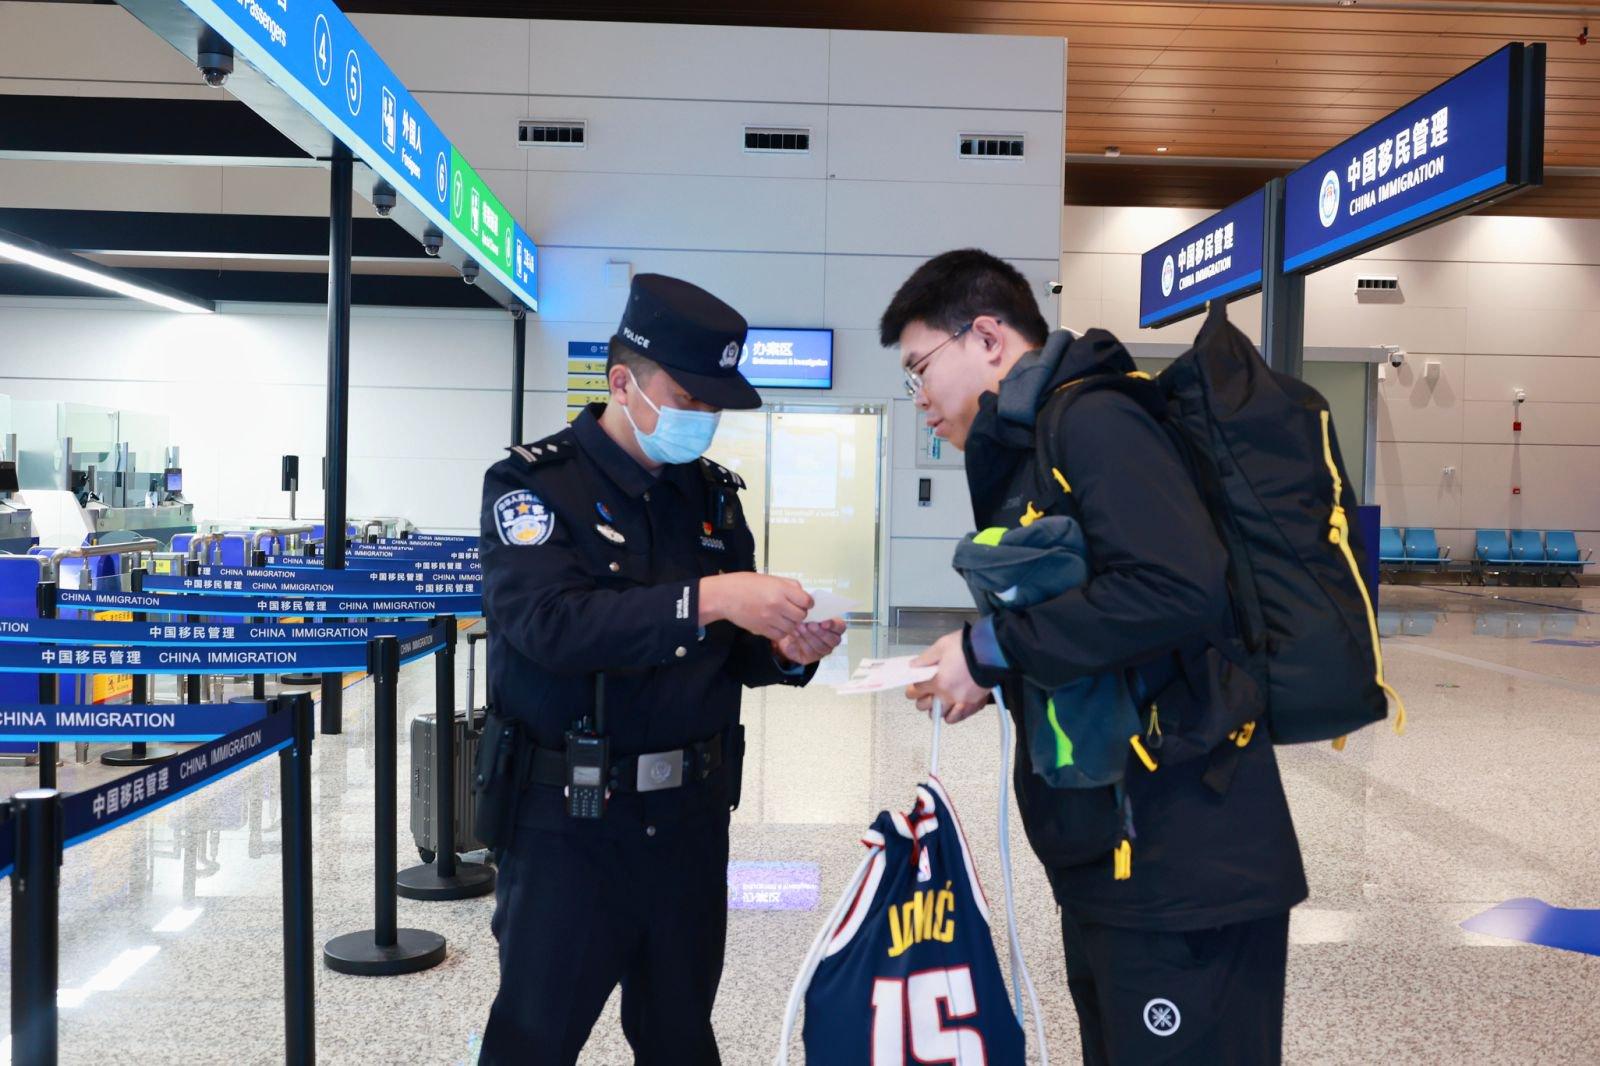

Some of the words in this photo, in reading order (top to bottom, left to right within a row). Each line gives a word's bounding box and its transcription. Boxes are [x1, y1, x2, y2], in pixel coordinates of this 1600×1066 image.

[402, 108, 422, 155] 外国人
[1347, 106, 1448, 191] 中国移民管理
[1349, 189, 1376, 217] CHINA
[1378, 155, 1444, 203] IMMIGRATION
[1178, 221, 1234, 273] 中国移民管理
[1179, 273, 1195, 291] CHINA
[1195, 255, 1232, 284] IMMIGRATION
[623, 327, 651, 349] POLICE
[414, 561, 462, 570] 中国移民管理
[220, 568, 243, 576] CHINA
[246, 569, 296, 579] IMMIGRATION
[369, 572, 424, 581] 中国移民管理
[183, 579, 243, 589] 中国移民管理
[252, 582, 277, 590] CHINA
[280, 583, 334, 592] IMMIGRATION
[415, 583, 474, 593] 中国移民管理
[61, 592, 91, 602] CHINA
[96, 594, 160, 606] IMMIGRATION
[339, 602, 368, 610] CHINA
[373, 601, 436, 610] IMMIGRATION
[257, 600, 327, 612] 中国移民管理
[0, 622, 29, 633] TION
[149, 626, 235, 639] 中国移民管理
[250, 628, 286, 638] CHINA
[291, 627, 368, 638] IMMIGRATION
[41, 649, 142, 664] 中国移民管理
[158, 652, 201, 663] CHINA
[208, 652, 297, 663] IMMIGRATION
[56, 712, 175, 728] IMMIGRATION
[179, 754, 208, 780] CHINA
[210, 729, 262, 765] IMMIGRATION
[92, 767, 170, 820] 中国移民管理
[871, 964, 989, 1066] 15
